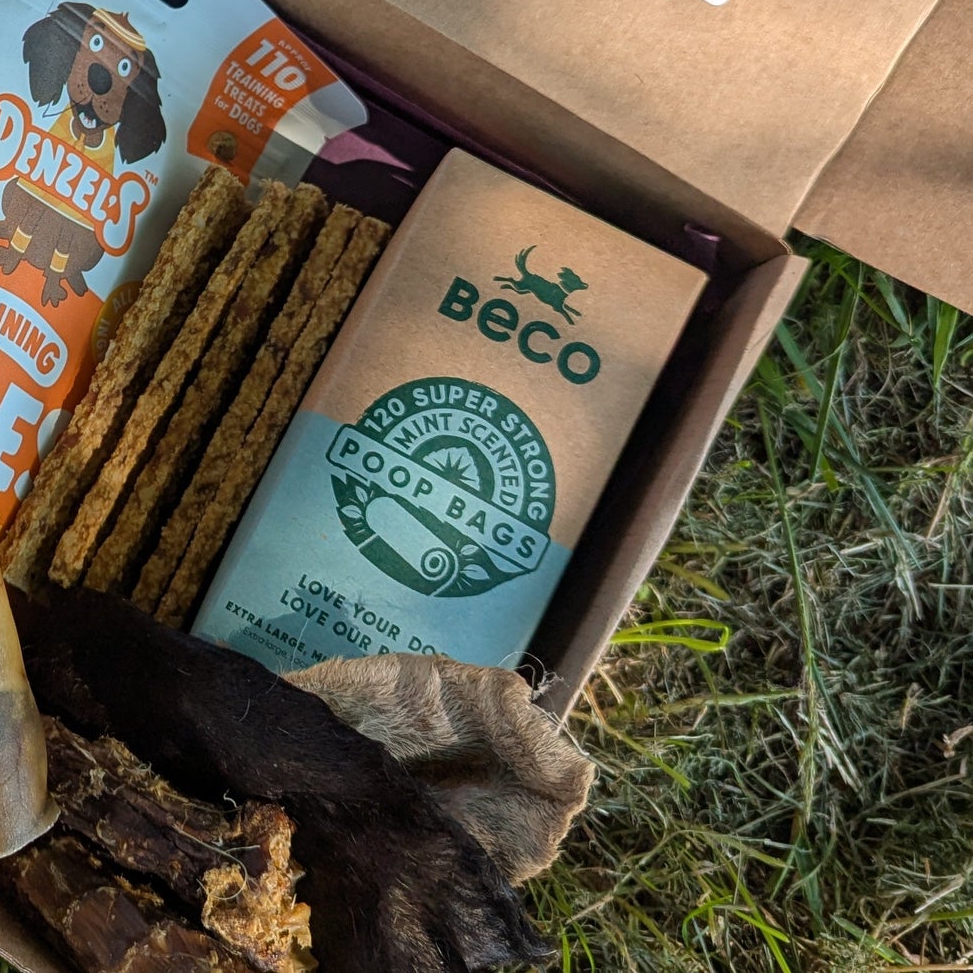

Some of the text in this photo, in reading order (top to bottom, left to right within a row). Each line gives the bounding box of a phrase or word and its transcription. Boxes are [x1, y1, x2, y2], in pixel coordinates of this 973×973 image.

[226, 61, 287, 109] TRAINING
[245, 38, 307, 91] 110
[213, 96, 263, 135] for DOGS
[223, 80, 267, 117] TREATS
[364, 384, 550, 522] 120 SUPER STRONG
[393, 413, 519, 507] MINT SCENTED
[339, 437, 536, 559] POOP BAGS
[225, 600, 307, 655] EXTRA LARGE,
[280, 589, 373, 651] LOVE OUR
[298, 573, 346, 610] LOVE
[351, 601, 401, 641] YOUR
